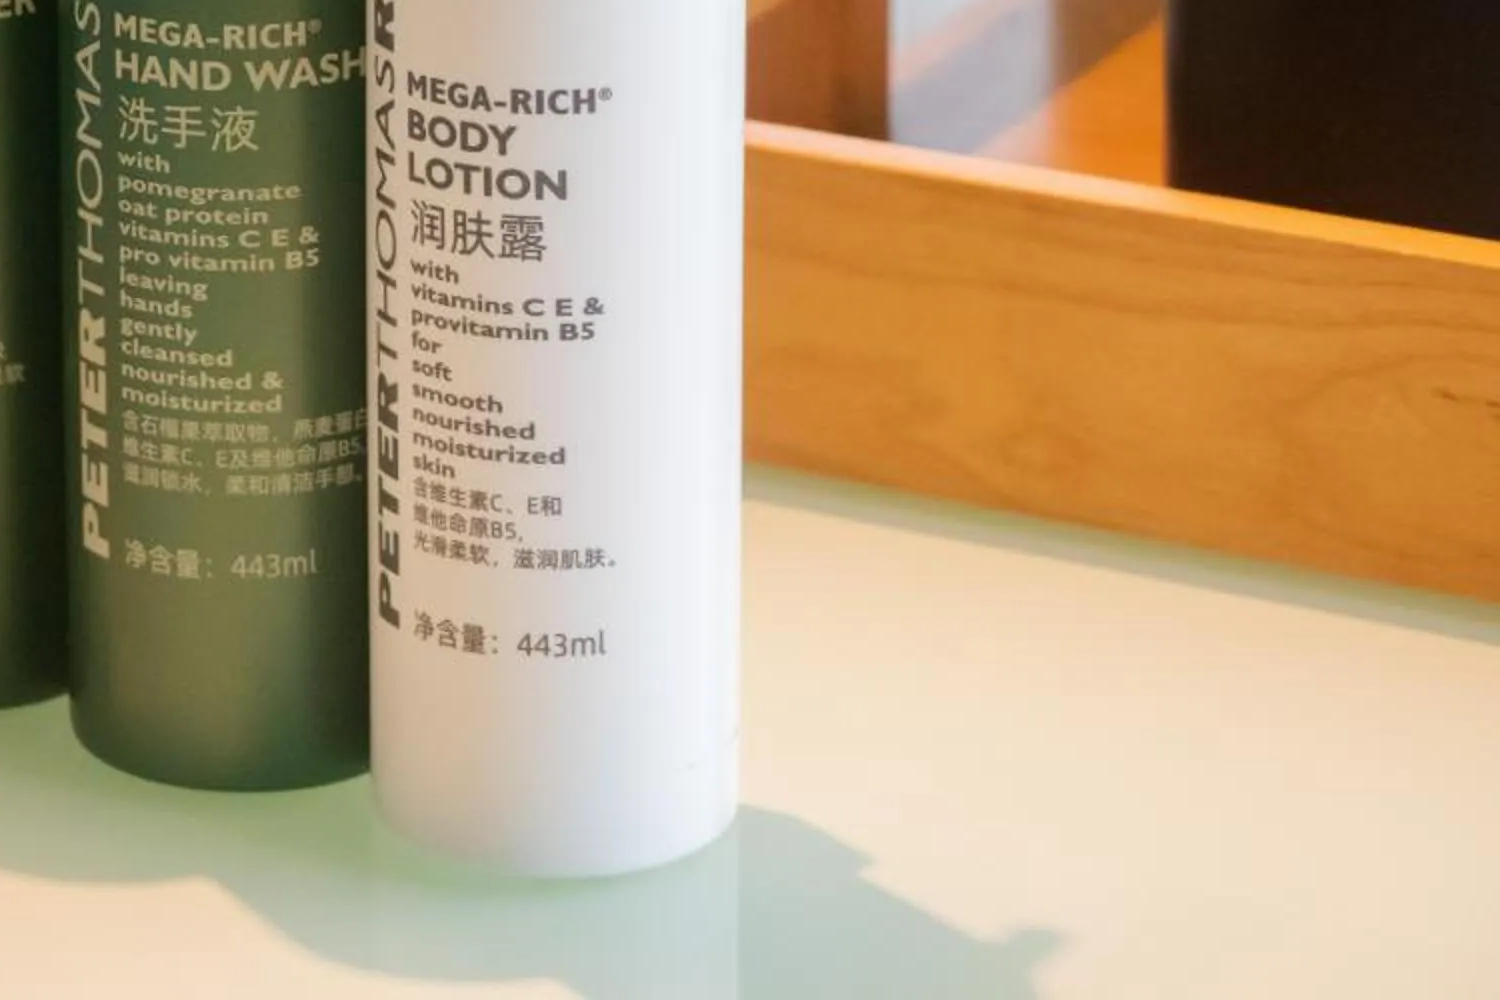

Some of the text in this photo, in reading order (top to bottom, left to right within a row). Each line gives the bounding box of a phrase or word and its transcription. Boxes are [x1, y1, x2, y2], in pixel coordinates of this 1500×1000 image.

[115, 47, 366, 92] HAND WASH
[119, 94, 259, 153] 洗手液
[408, 108, 517, 156] BODY
[118, 152, 170, 174] with
[408, 151, 568, 201] LOTION
[118, 175, 301, 205] pomegranate
[118, 200, 268, 226] oat protein
[120, 220, 319, 249] vitamins C E &
[410, 200, 547, 263] 润肤露
[120, 245, 319, 272] pro vitamin B5
[410, 259, 459, 284] with
[120, 268, 208, 301] leaving
[120, 292, 193, 318] hands
[411, 285, 604, 316] vitamins C E &
[121, 318, 197, 346] gently
[411, 309, 595, 342] provitamin B5
[121, 340, 233, 367] cleansed
[412, 331, 442, 355] for
[122, 363, 284, 390] nourished &
[413, 358, 453, 382] soft
[123, 386, 282, 413] moisturized
[413, 383, 503, 414] smooth
[414, 407, 535, 441] nourished
[414, 432, 566, 466] moisturized
[414, 454, 456, 479] skin
[231, 550, 317, 578] 443ml
[414, 610, 606, 658] 净含量： 443ml
